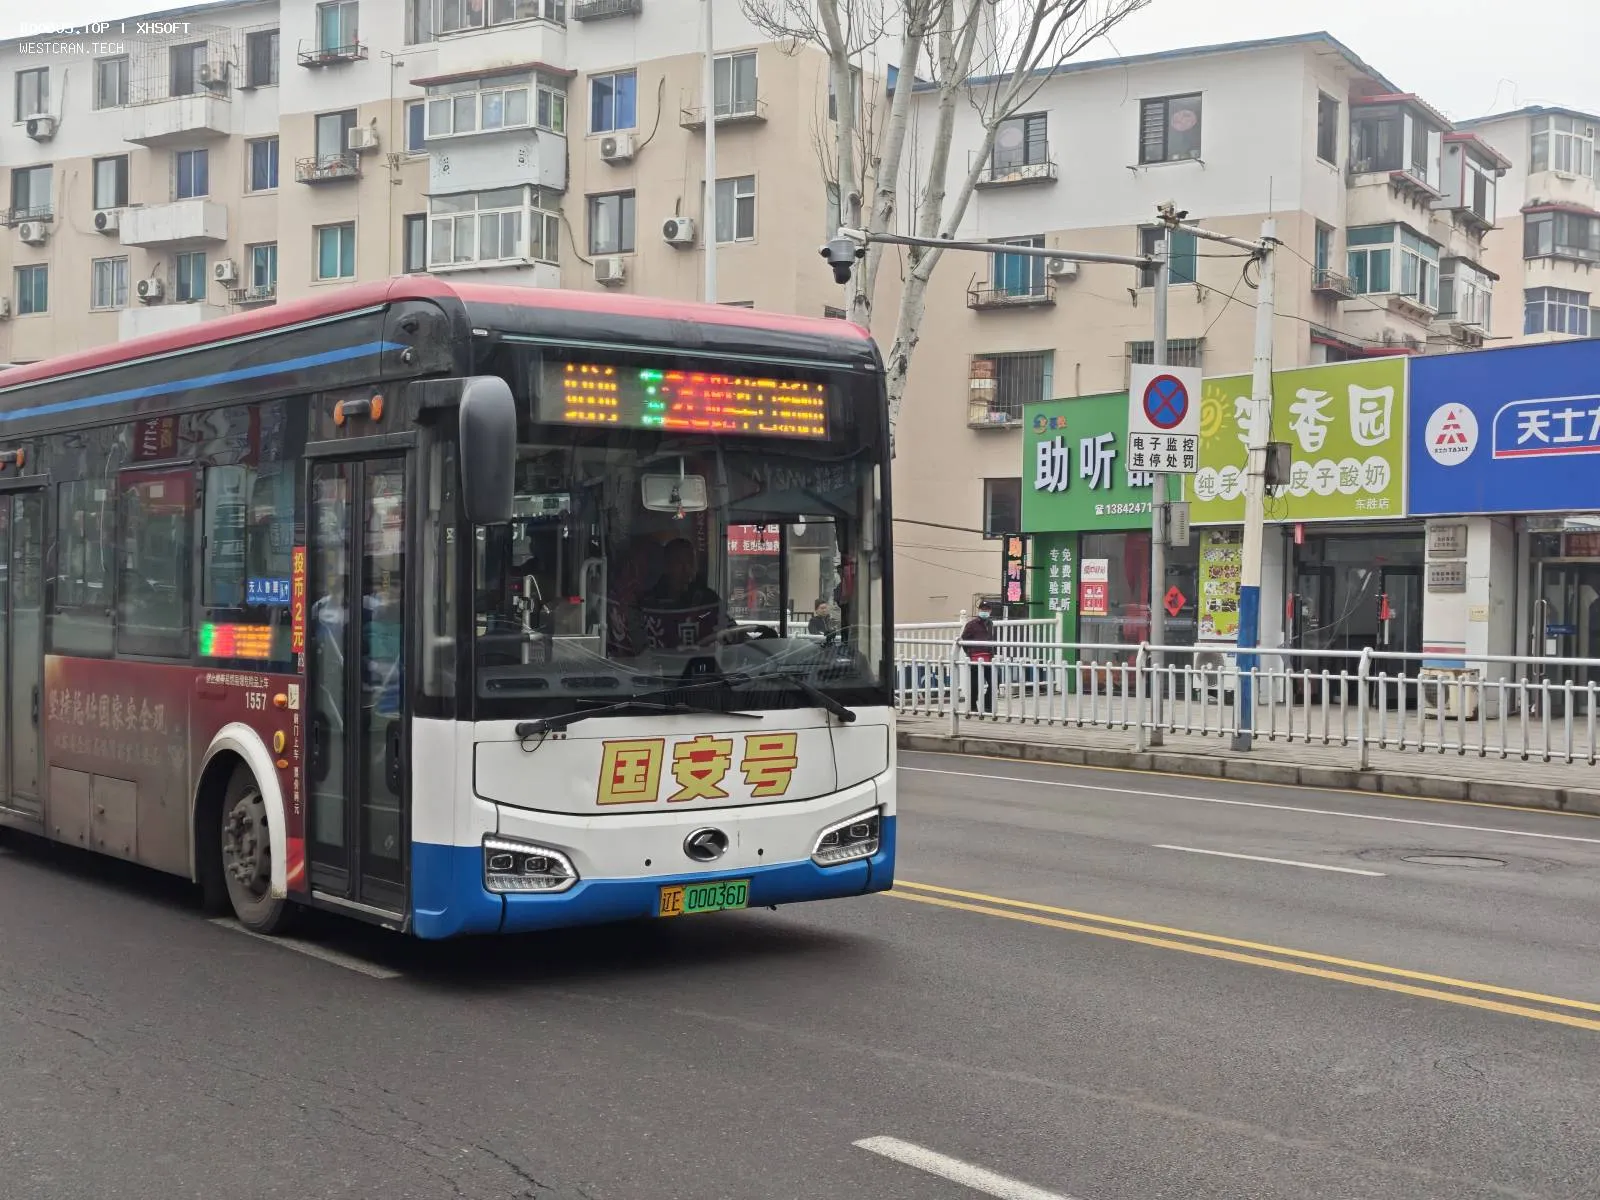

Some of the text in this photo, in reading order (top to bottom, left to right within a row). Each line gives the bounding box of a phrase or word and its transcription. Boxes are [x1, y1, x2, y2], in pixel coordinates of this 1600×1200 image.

[1133, 437, 1194, 452] 电子监控
[1133, 453, 1194, 469] 违停处罚
[1198, 463, 1385, 495] 纯手皮子酸奶
[1049, 548, 1059, 610] 专业验配
[1061, 548, 1072, 610] 免费测听
[294, 552, 304, 647] 投币2元
[245, 692, 267, 710] 1557
[597, 733, 798, 805] 国安号
[688, 884, 747, 910] 00036D
